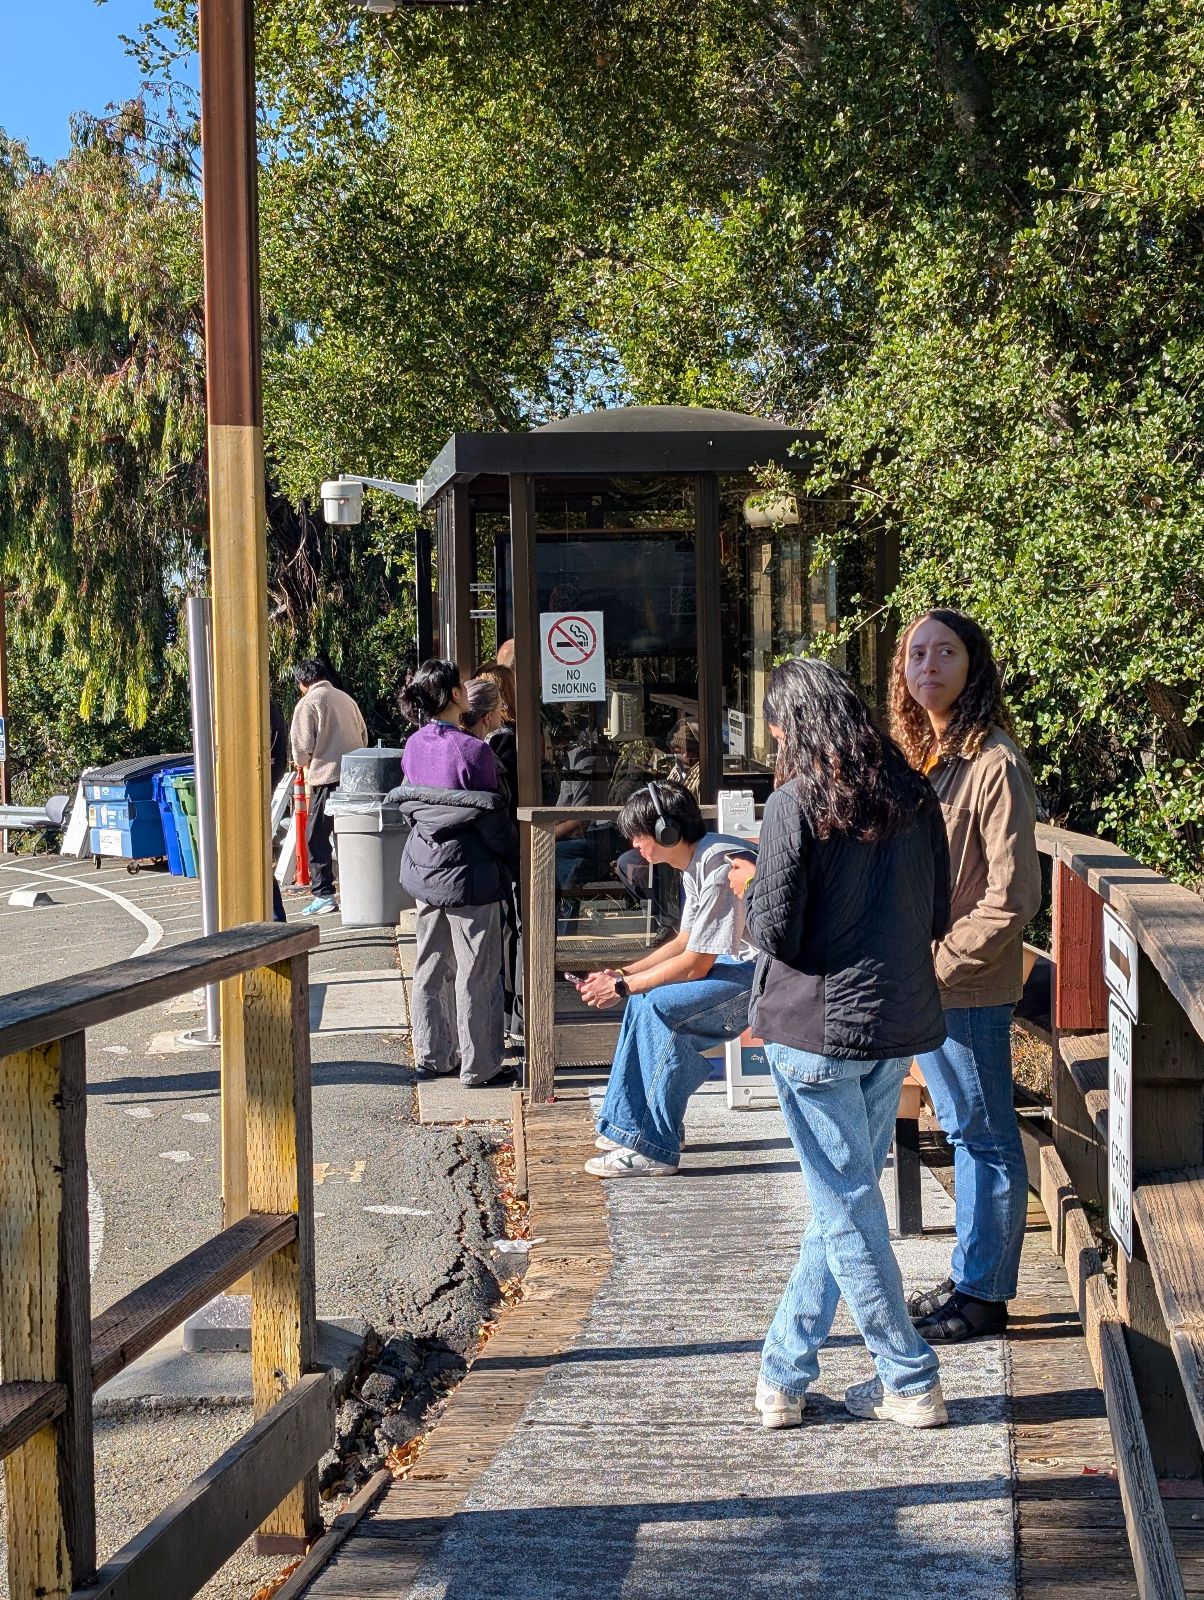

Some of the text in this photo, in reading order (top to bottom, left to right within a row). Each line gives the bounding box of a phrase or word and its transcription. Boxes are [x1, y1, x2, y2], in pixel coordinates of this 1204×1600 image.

[551, 682, 596, 694] SMOKING
[566, 669, 580, 680] NO
[1112, 1022, 1129, 1065] CROSS
[1113, 1068, 1126, 1108] ONLY
[1112, 1140, 1129, 1189] CROSS
[1112, 1182, 1129, 1234] WALKS
